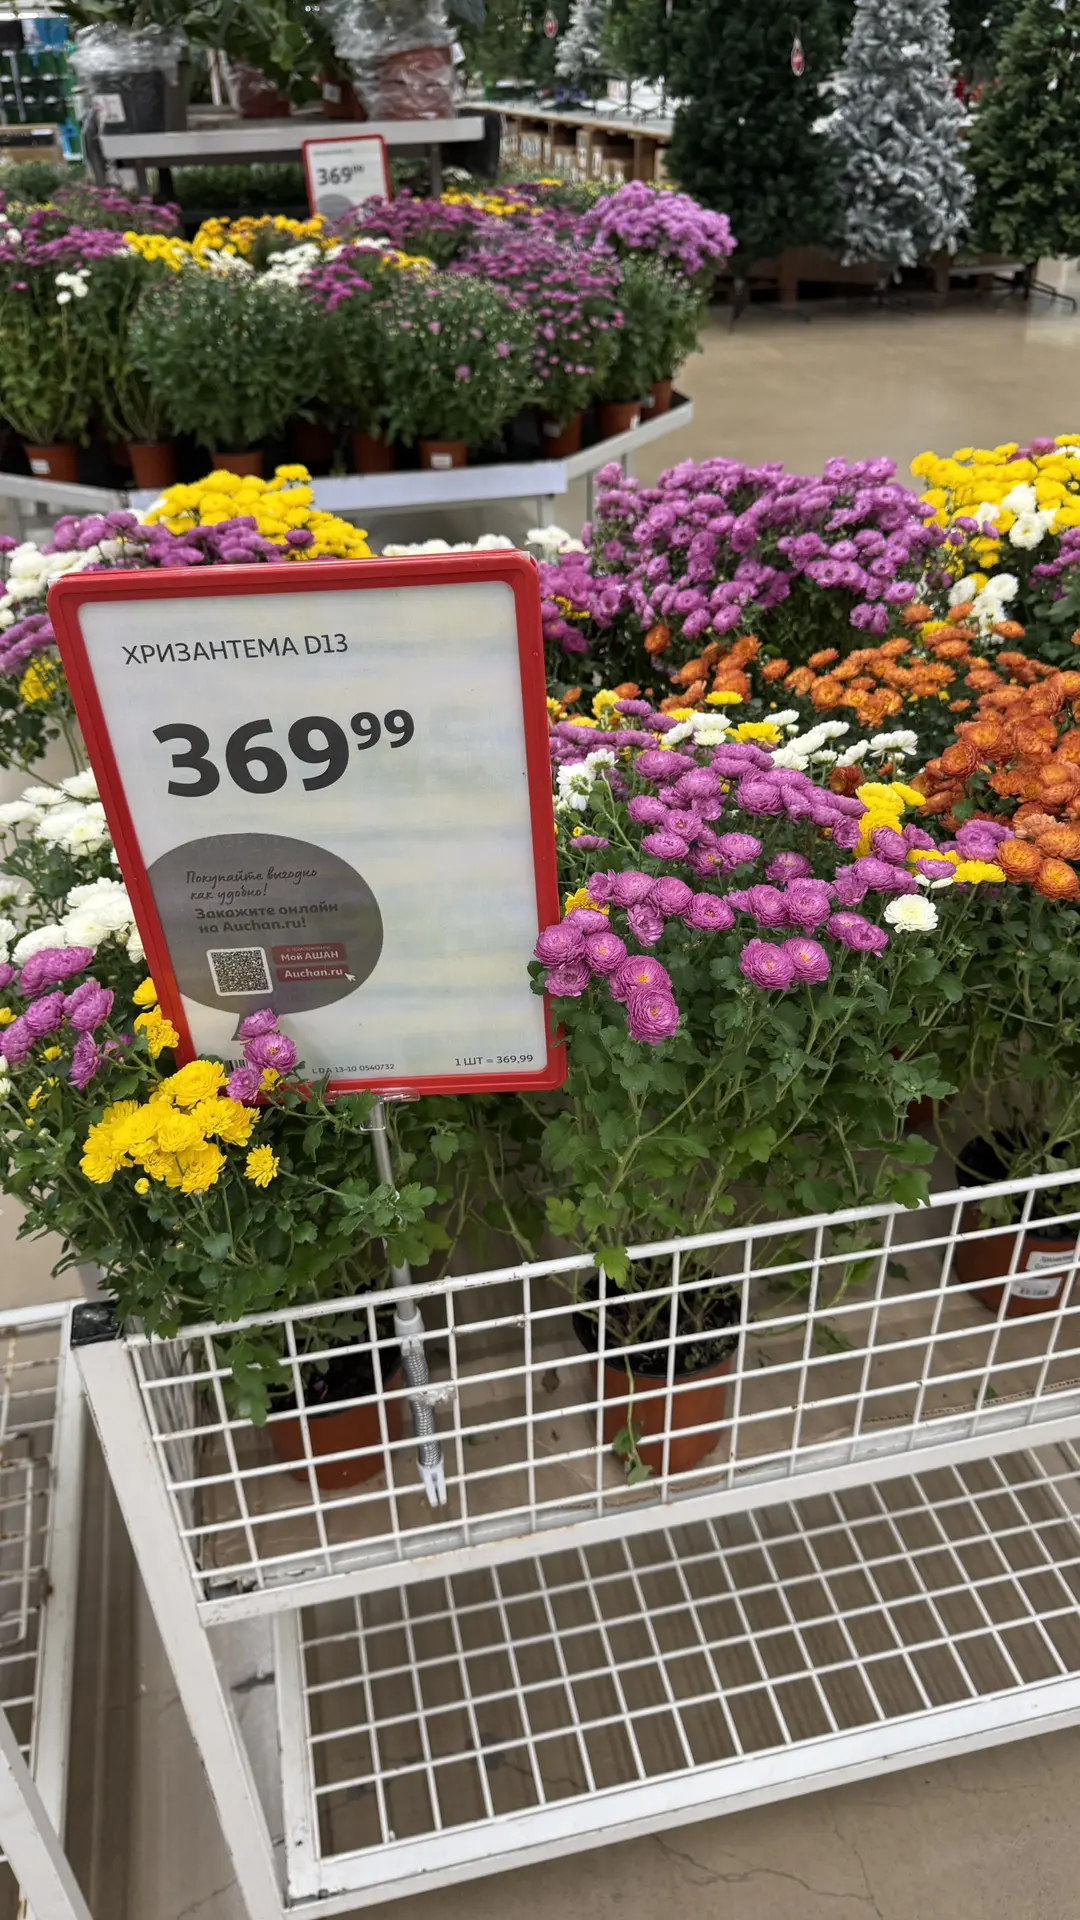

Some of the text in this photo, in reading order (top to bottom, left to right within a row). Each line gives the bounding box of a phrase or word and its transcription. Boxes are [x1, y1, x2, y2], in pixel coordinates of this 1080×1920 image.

[122, 633, 349, 665] ХРИЗАНТЕМА D13
[186, 866, 318, 889] Покупайте выгодно
[190, 883, 268, 905] как удобно!
[195, 901, 339, 920] Закажите онлайн
[199, 917, 307, 934] на Auchan.ru!
[281, 950, 339, 962] Мой АШАН
[284, 968, 343, 979] Auchan.ru
[359, 1063, 395, 1072] 0540732
[463, 1057, 483, 1066] ШТ
[496, 1054, 534, 1064] 369,99
